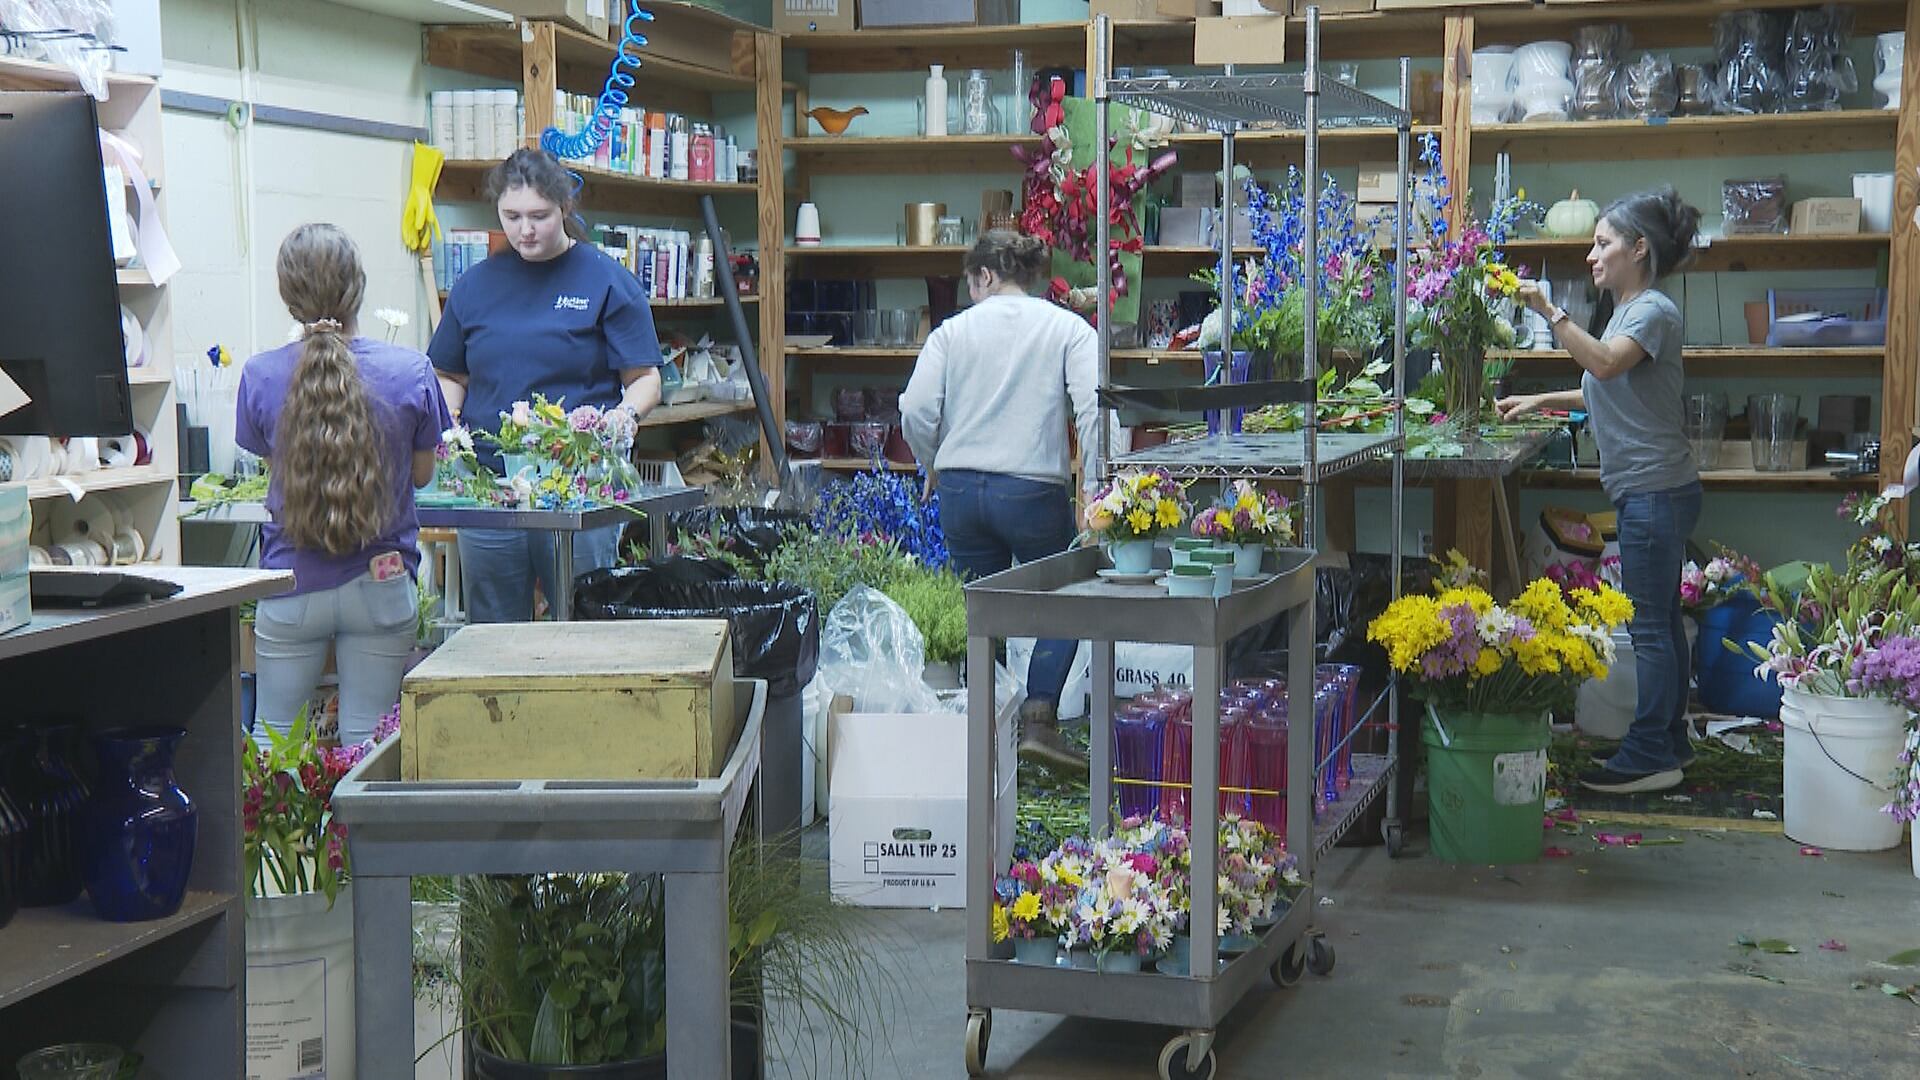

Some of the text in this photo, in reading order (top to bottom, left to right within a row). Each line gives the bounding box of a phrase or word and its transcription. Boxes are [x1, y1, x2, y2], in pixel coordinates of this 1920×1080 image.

[1116, 667, 1186, 686] GRASS 40
[881, 843, 957, 858] SALAL TIP 25
[883, 879, 910, 888] PRODUCT
[911, 879, 919, 887] OF
